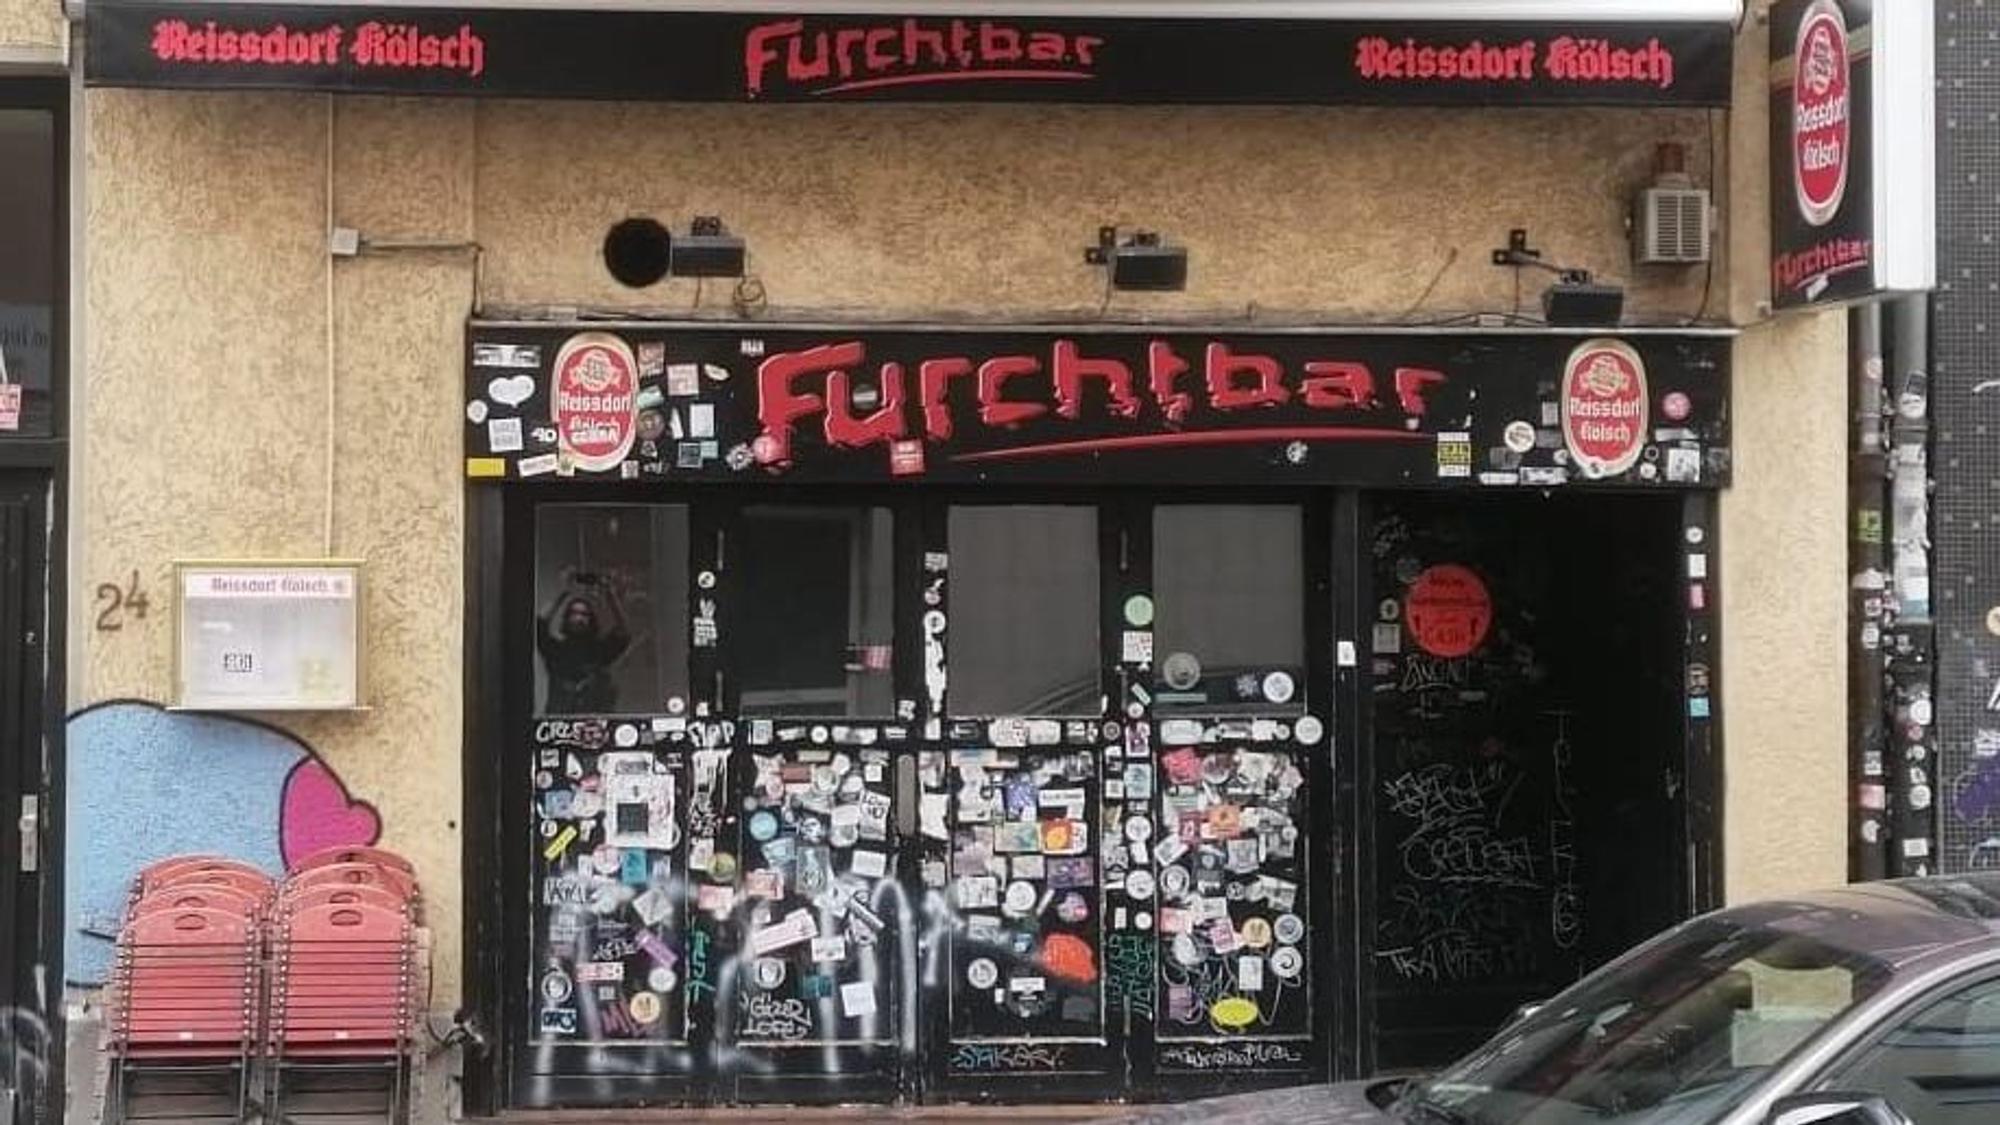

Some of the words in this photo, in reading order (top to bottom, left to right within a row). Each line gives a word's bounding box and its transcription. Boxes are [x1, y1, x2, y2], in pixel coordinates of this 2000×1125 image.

[152, 19, 343, 64] Reissdorf
[349, 21, 484, 75] Kölsch
[745, 20, 1104, 97] Furchtbar
[1357, 36, 1535, 81] Reissdorf
[1544, 35, 1674, 88] Kölsch
[560, 391, 631, 412] Reissdorf
[758, 340, 1446, 468] Furchtbar
[1570, 397, 1640, 418] Reissdorf
[96, 569, 149, 631] 24
